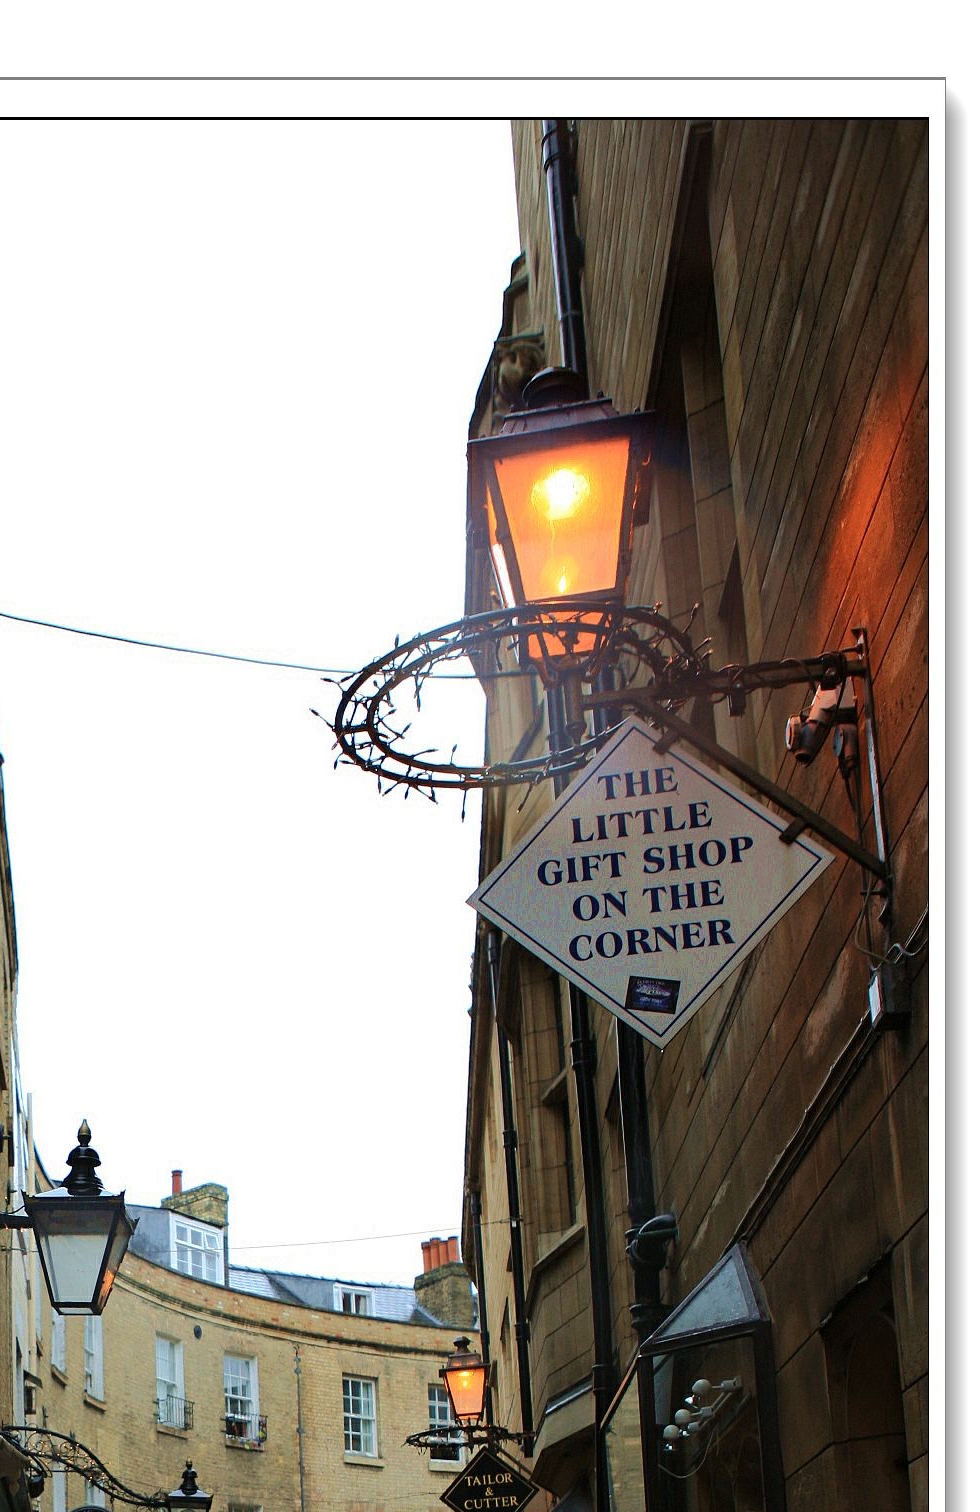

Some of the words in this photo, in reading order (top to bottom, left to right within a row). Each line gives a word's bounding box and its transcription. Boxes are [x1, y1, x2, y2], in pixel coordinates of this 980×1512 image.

[597, 766, 679, 801] THE
[570, 801, 713, 844] LITTLE
[537, 850, 627, 887] GIFT
[642, 836, 754, 875] SHOP
[572, 890, 629, 922] ON
[642, 880, 726, 913] THE
[568, 919, 736, 962] CORNER
[464, 1472, 514, 1487] TAILOR
[484, 1486, 494, 1497] &
[464, 1495, 519, 1510] CUTTER
